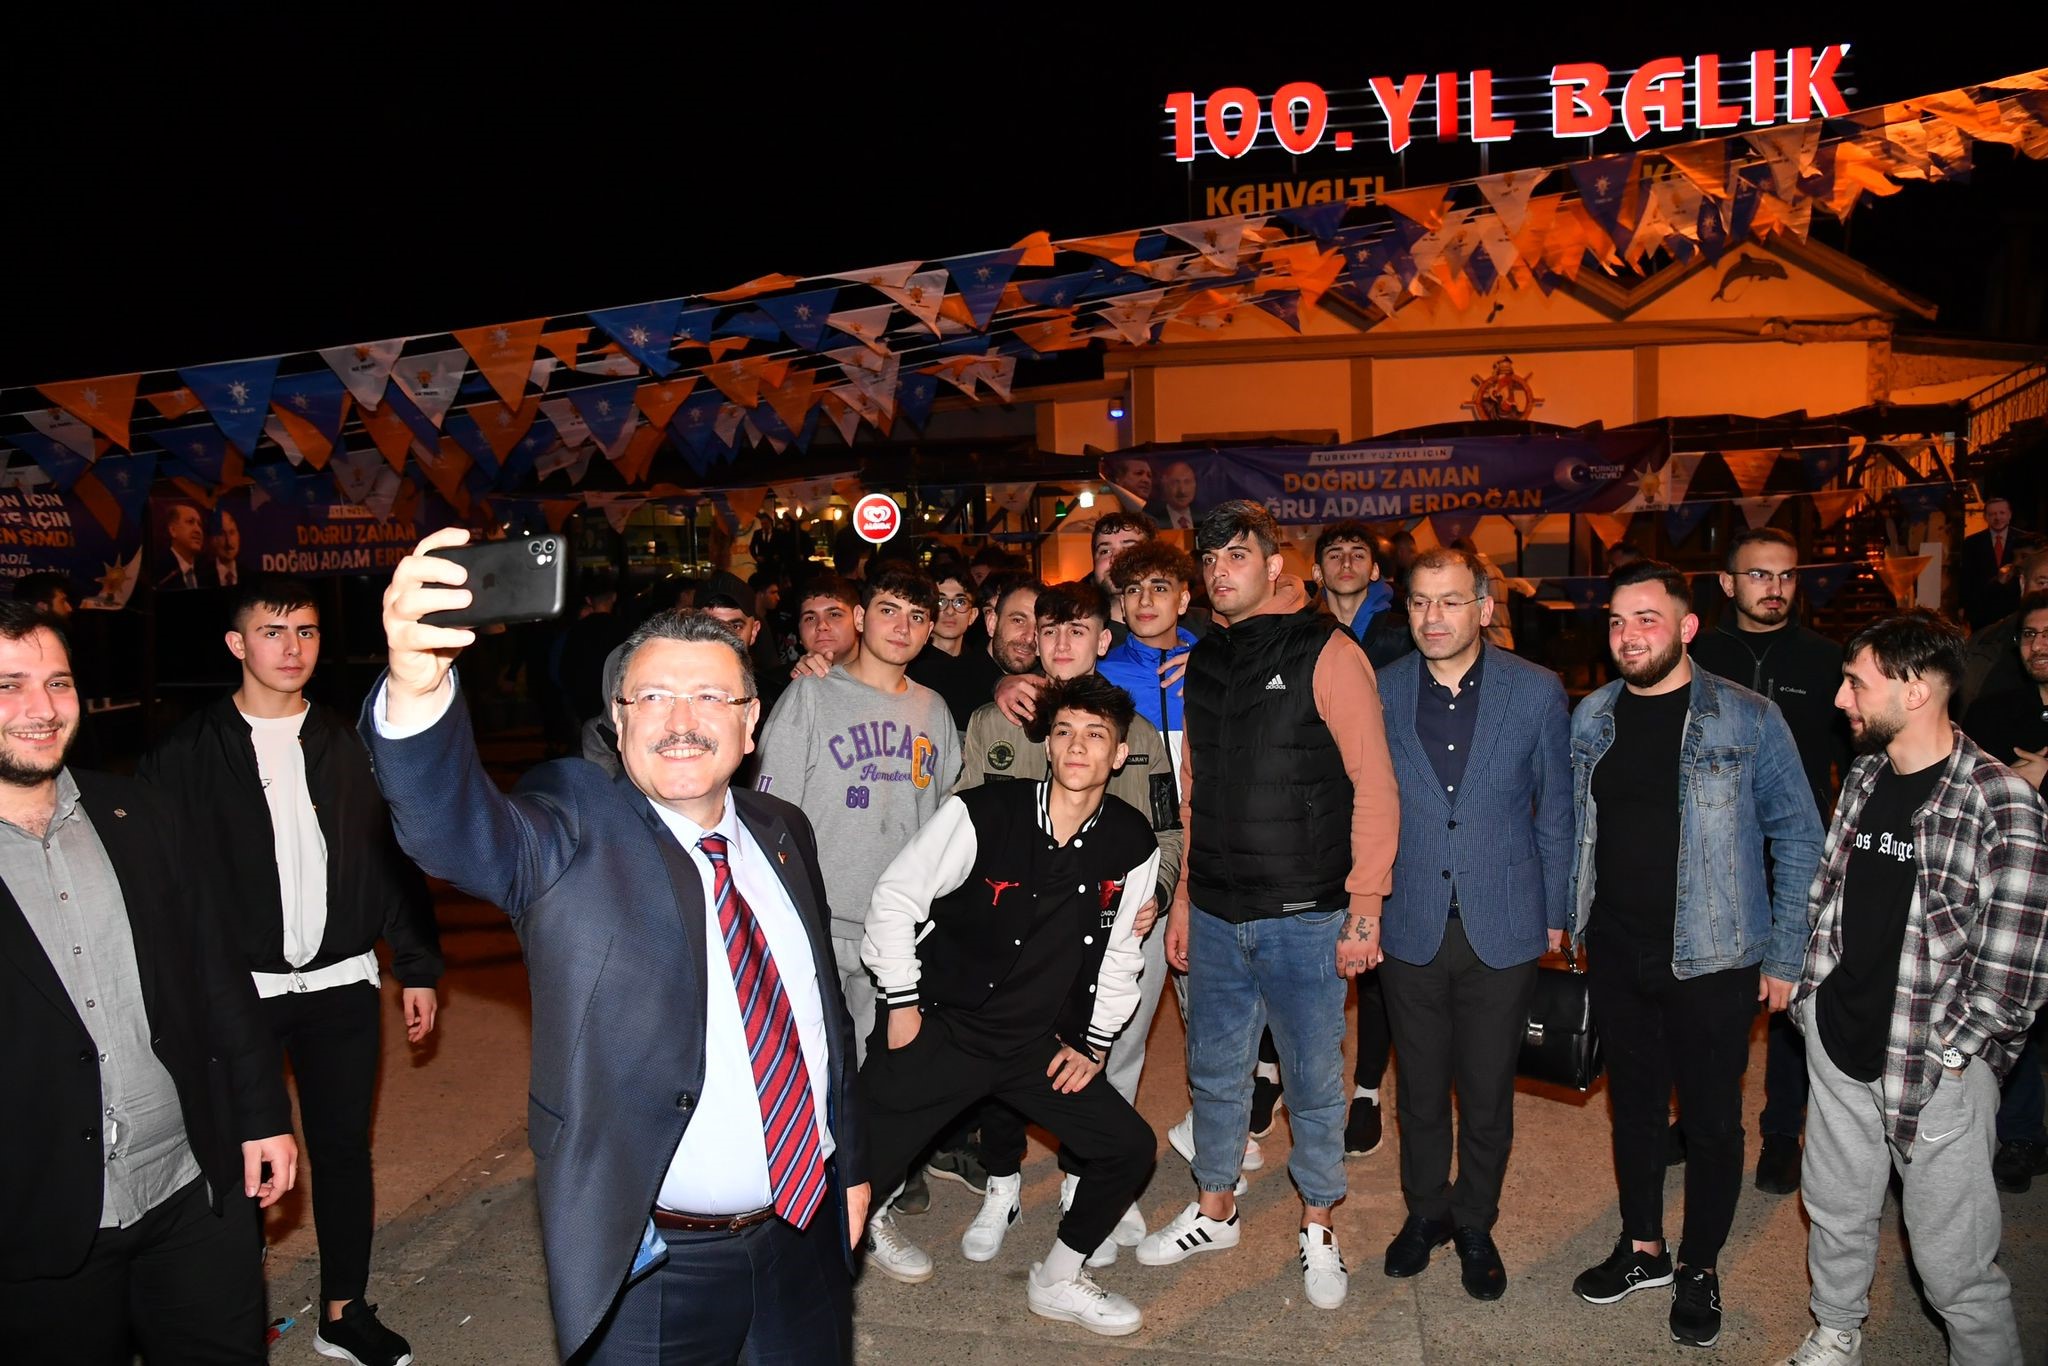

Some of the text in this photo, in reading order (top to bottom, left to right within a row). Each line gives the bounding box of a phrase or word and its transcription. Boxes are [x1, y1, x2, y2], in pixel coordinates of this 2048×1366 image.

[1163, 43, 1851, 162] 100. YIL BALIK
[1205, 175, 1386, 217] KAHVALTI
[1283, 464, 1481, 493] DOĞRU ZAMAN
[1321, 494, 1402, 518] ADAM
[1409, 488, 1543, 514] ERDOĞAN
[354, 523, 417, 545] ZAMAN
[261, 548, 318, 572] DOĞRU
[320, 548, 370, 571] ADAM
